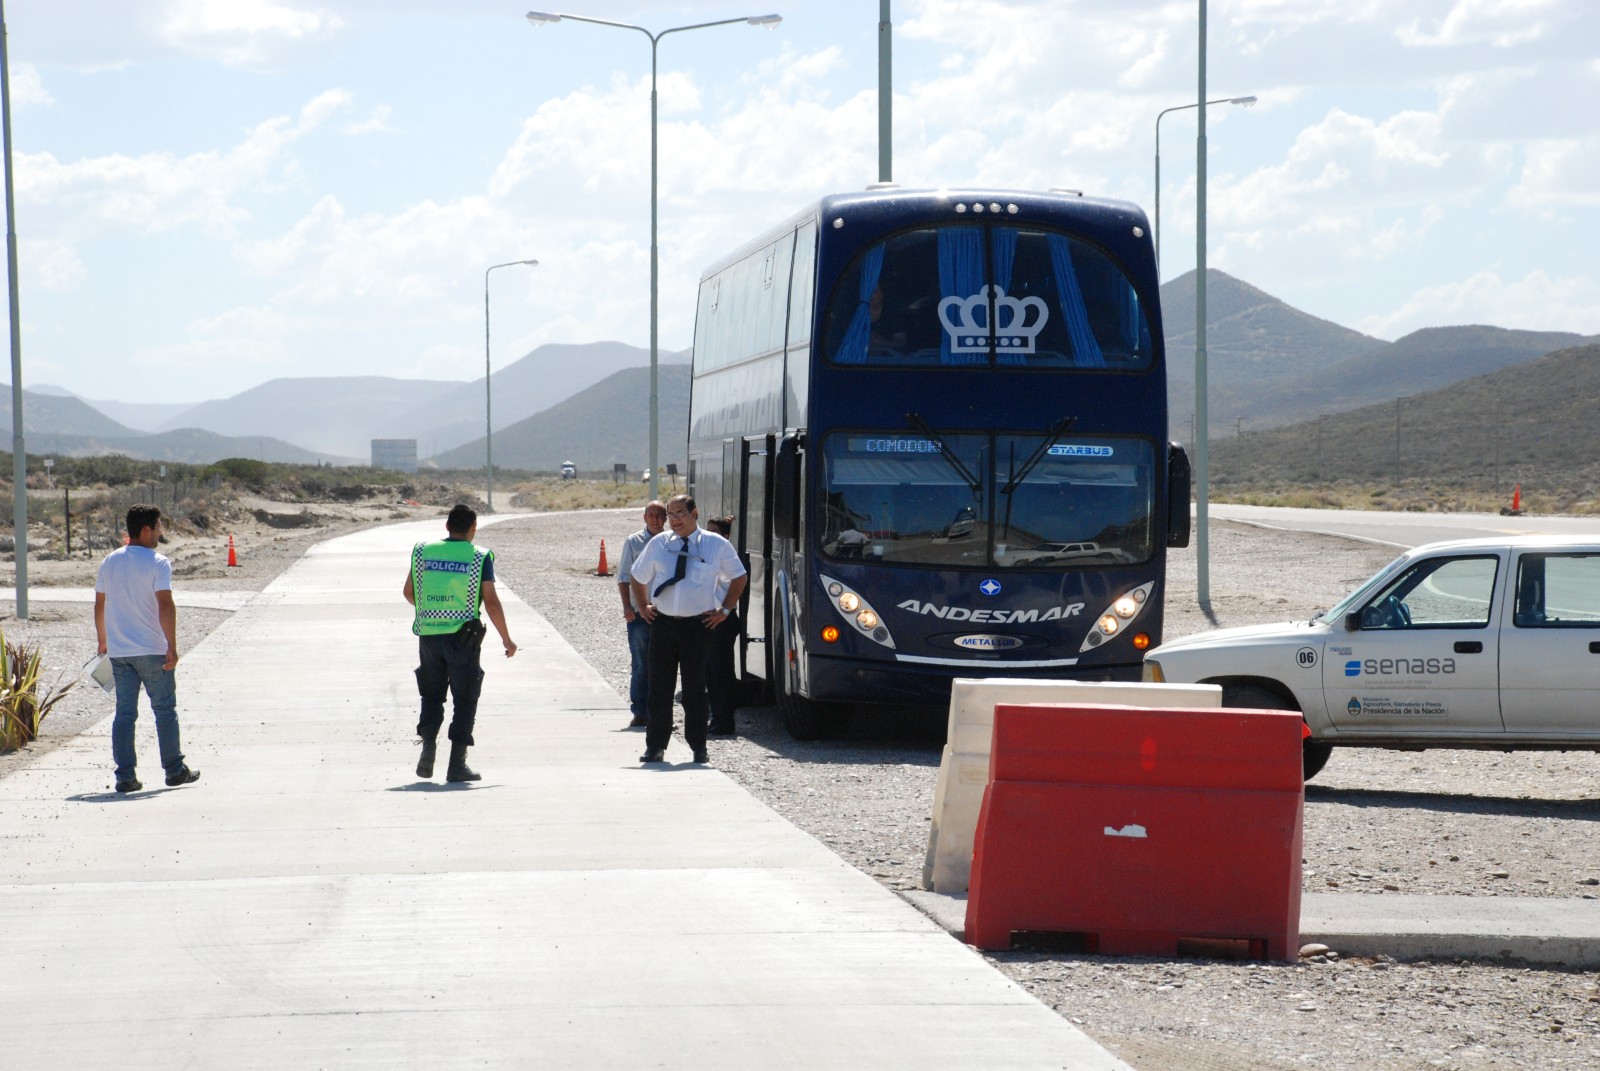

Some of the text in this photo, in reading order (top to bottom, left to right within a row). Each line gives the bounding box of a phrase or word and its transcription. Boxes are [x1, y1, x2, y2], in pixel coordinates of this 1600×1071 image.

[1050, 445, 1110, 455] STARBUS
[425, 561, 466, 572] POLICIA
[426, 594, 455, 602] CHUBUT
[896, 599, 1085, 624] ANDESMAR
[962, 638, 1015, 646] METALSUR
[1299, 651, 1314, 664] 06
[1364, 658, 1456, 675] senasa
